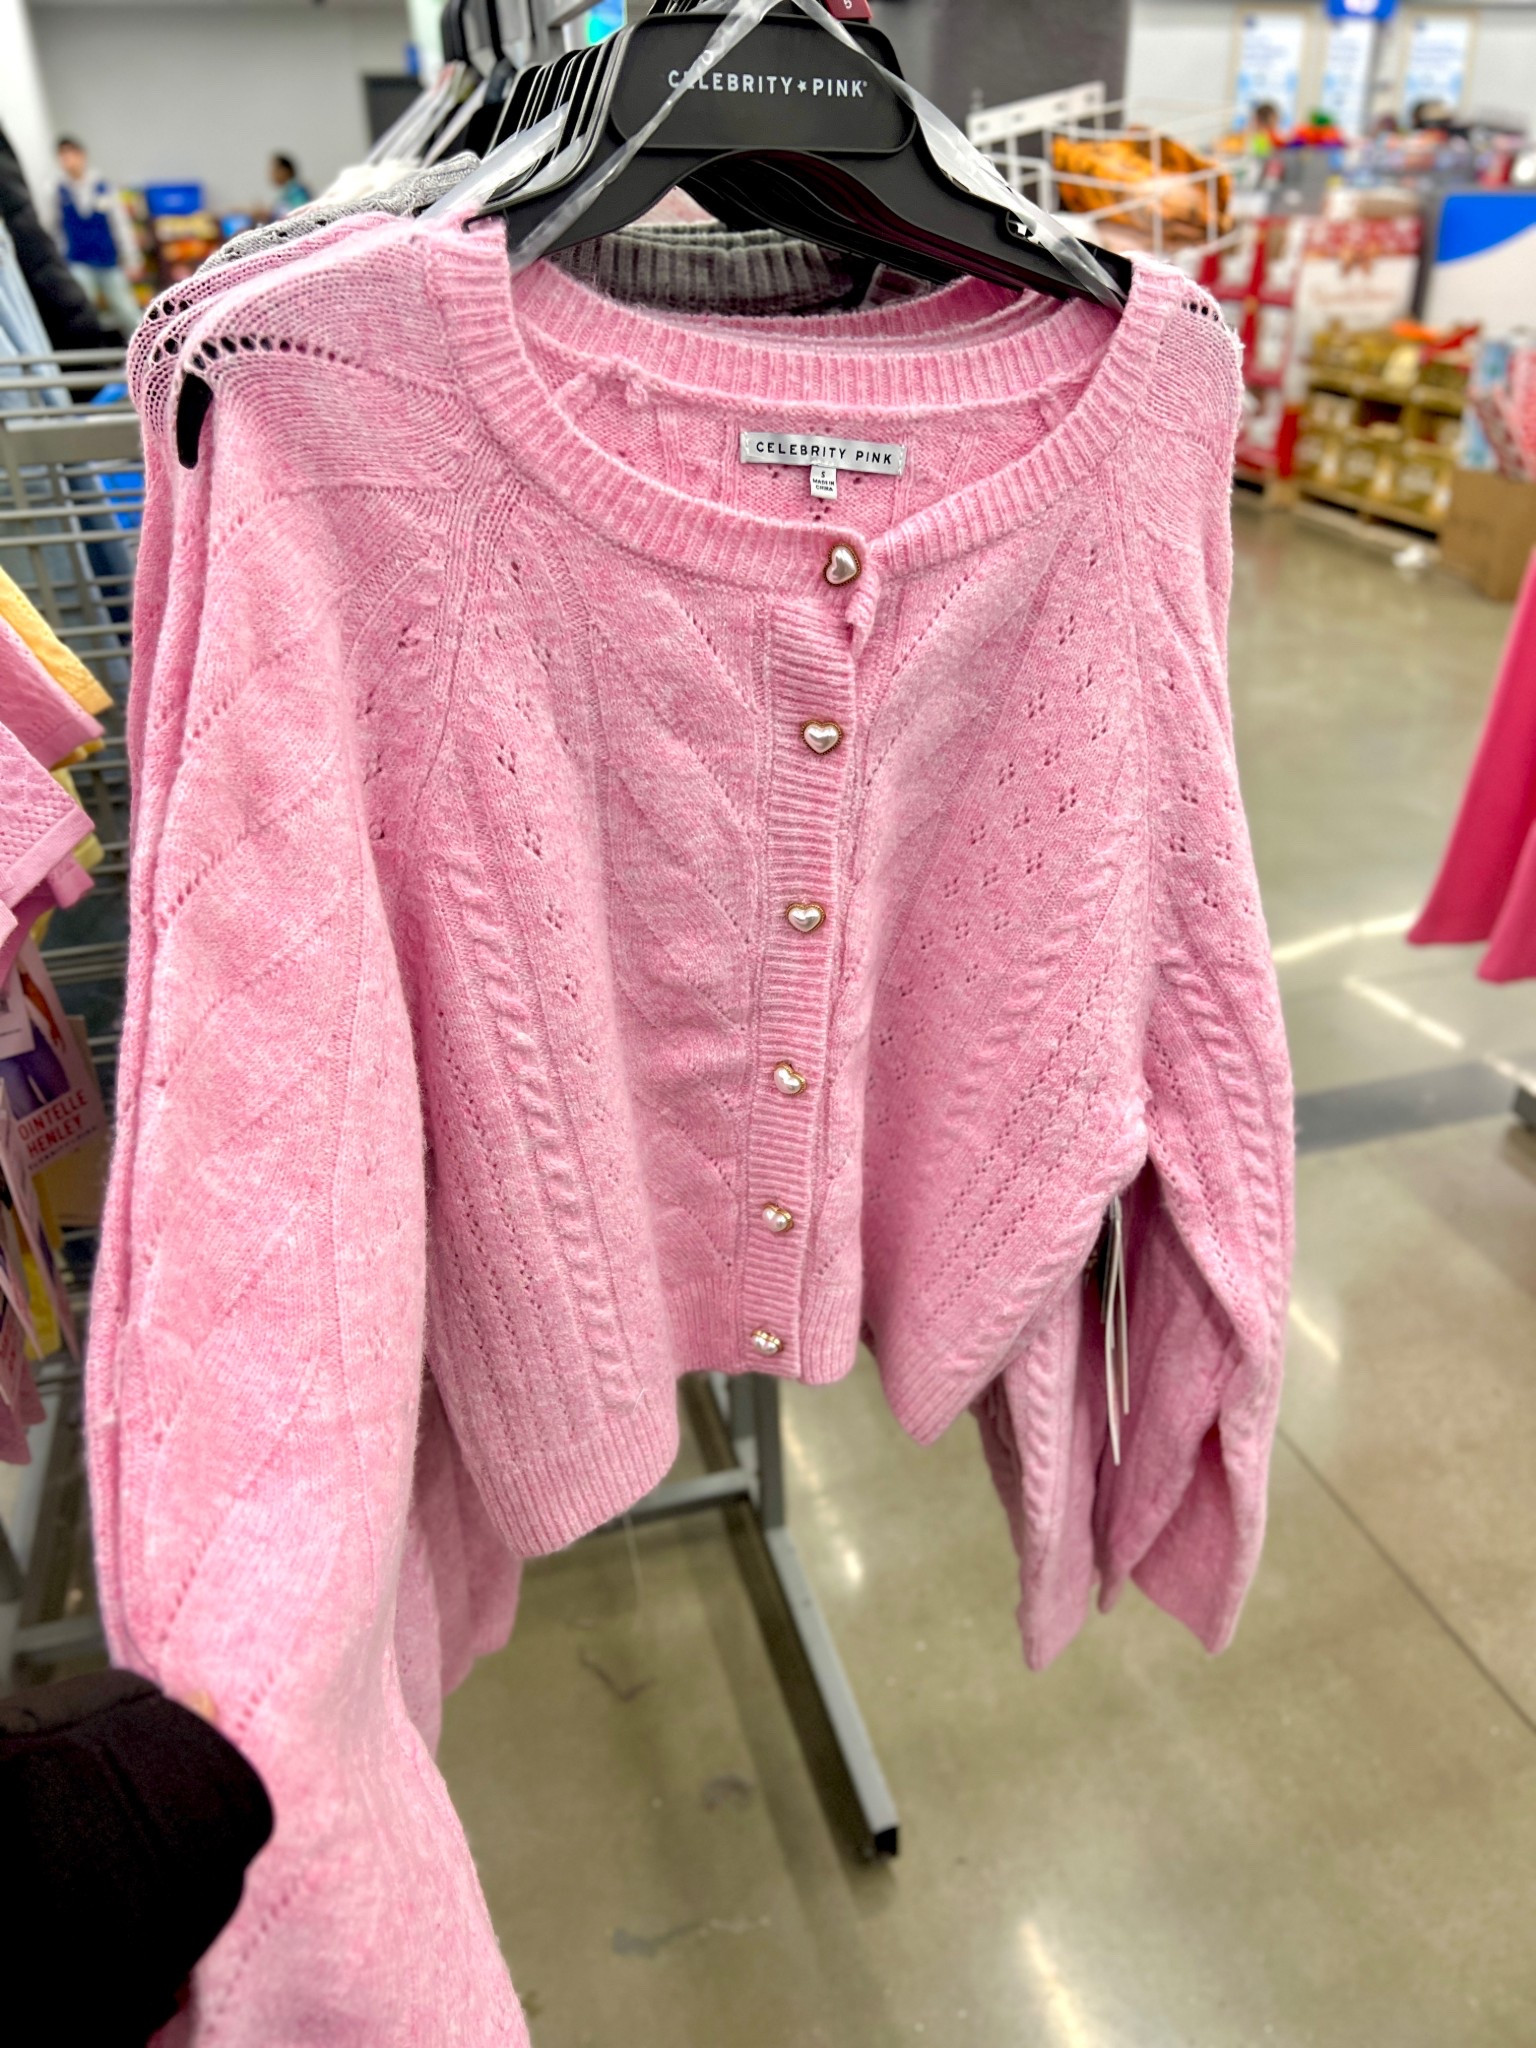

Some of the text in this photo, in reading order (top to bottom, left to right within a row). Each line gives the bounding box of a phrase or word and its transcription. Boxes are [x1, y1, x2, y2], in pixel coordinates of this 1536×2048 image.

[812, 77, 864, 98] PINK
[756, 441, 892, 465] CELEBRITY PINK
[18, 1089, 88, 1140] OINTELLE
[27, 1114, 82, 1158] HENLEY
